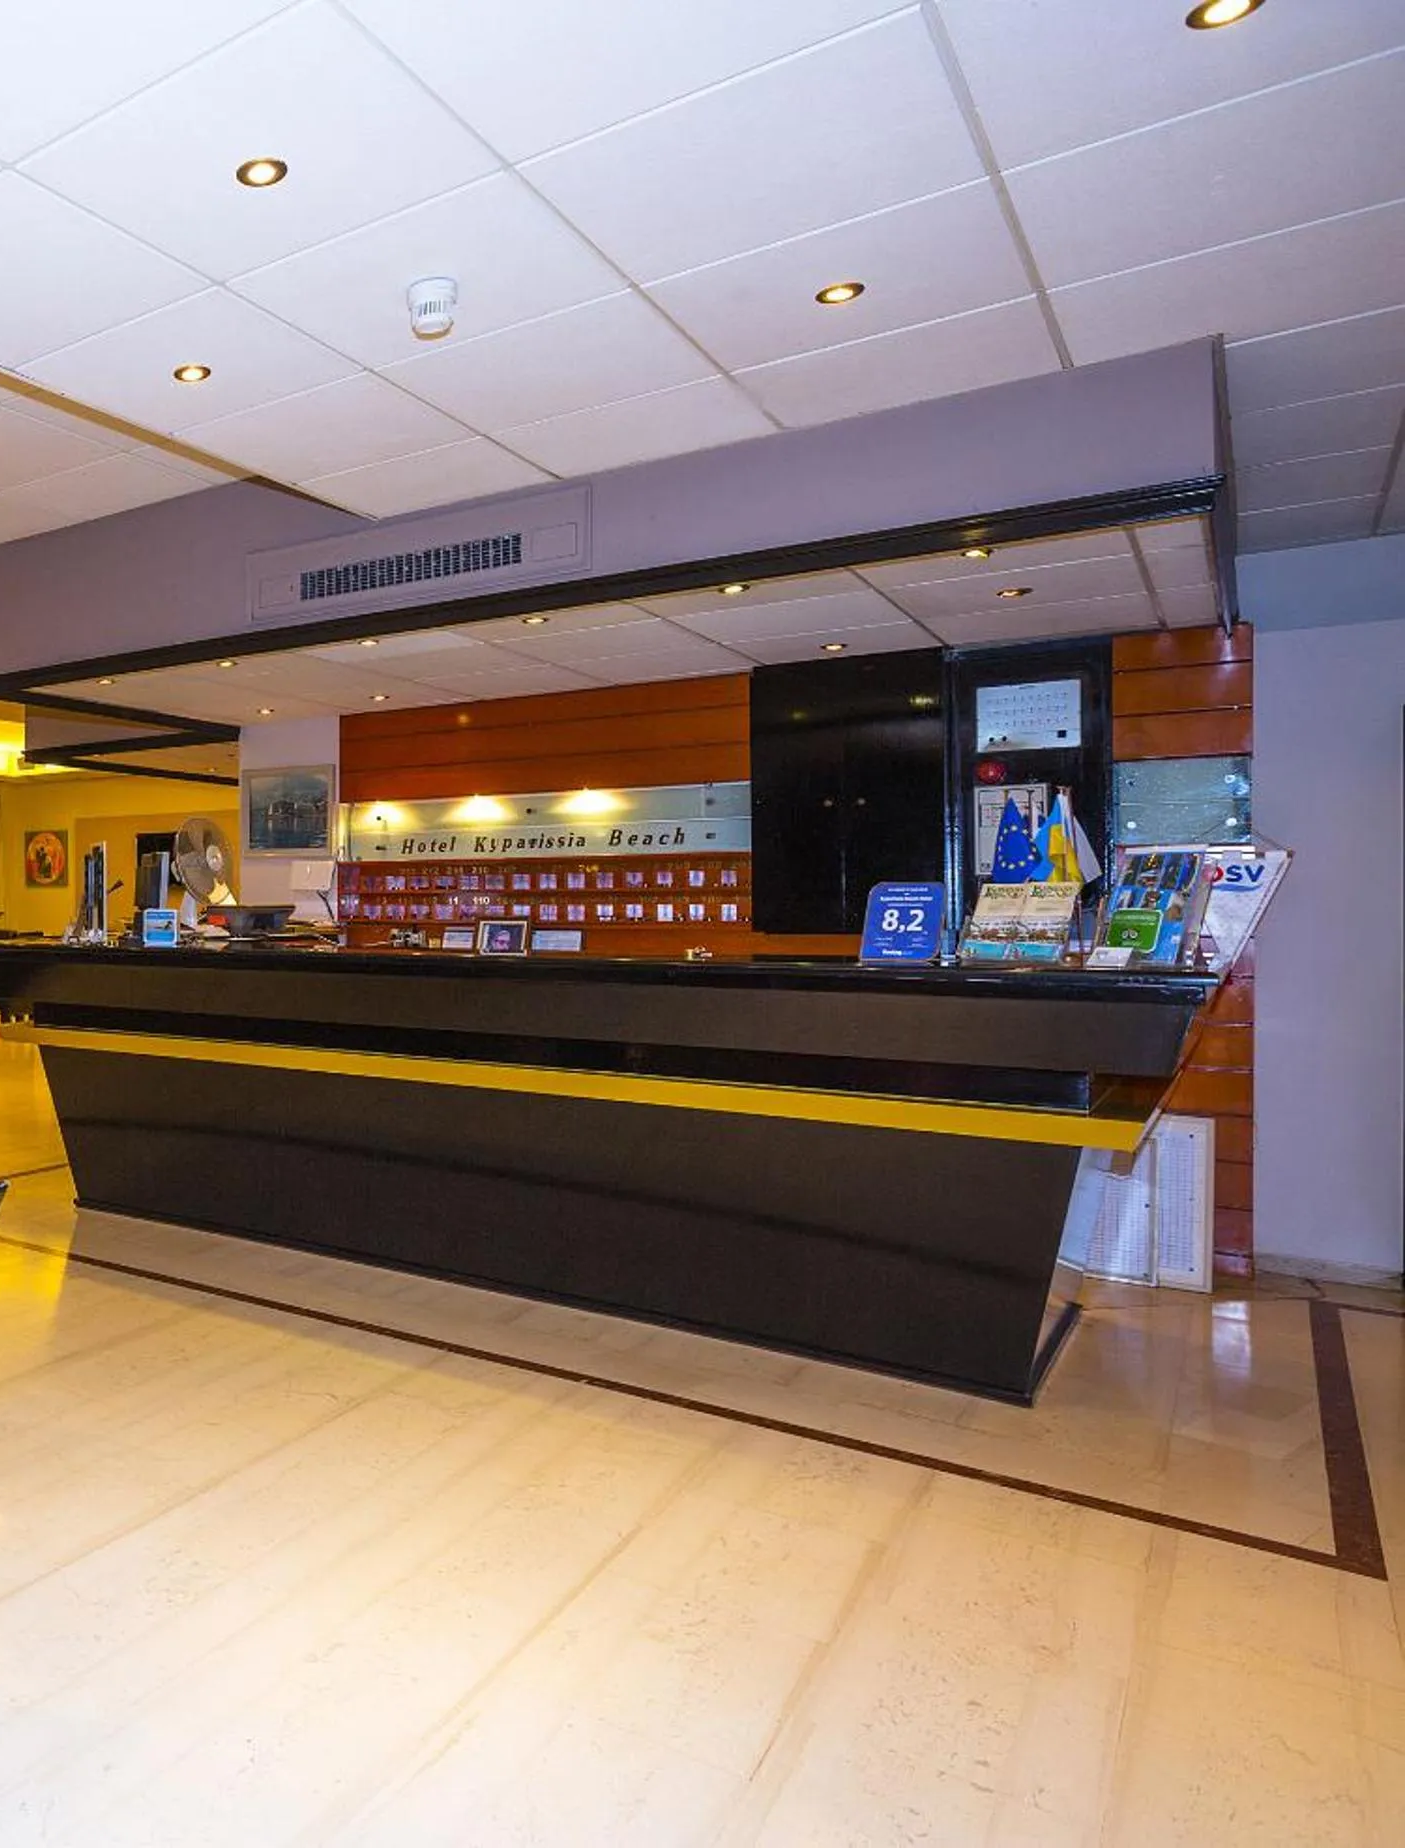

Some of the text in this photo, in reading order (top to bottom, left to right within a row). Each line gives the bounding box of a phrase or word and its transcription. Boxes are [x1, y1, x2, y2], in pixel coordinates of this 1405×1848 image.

[401, 826, 686, 855] Hotel Kyparissia Beach
[881, 908, 925, 934] 8,2
